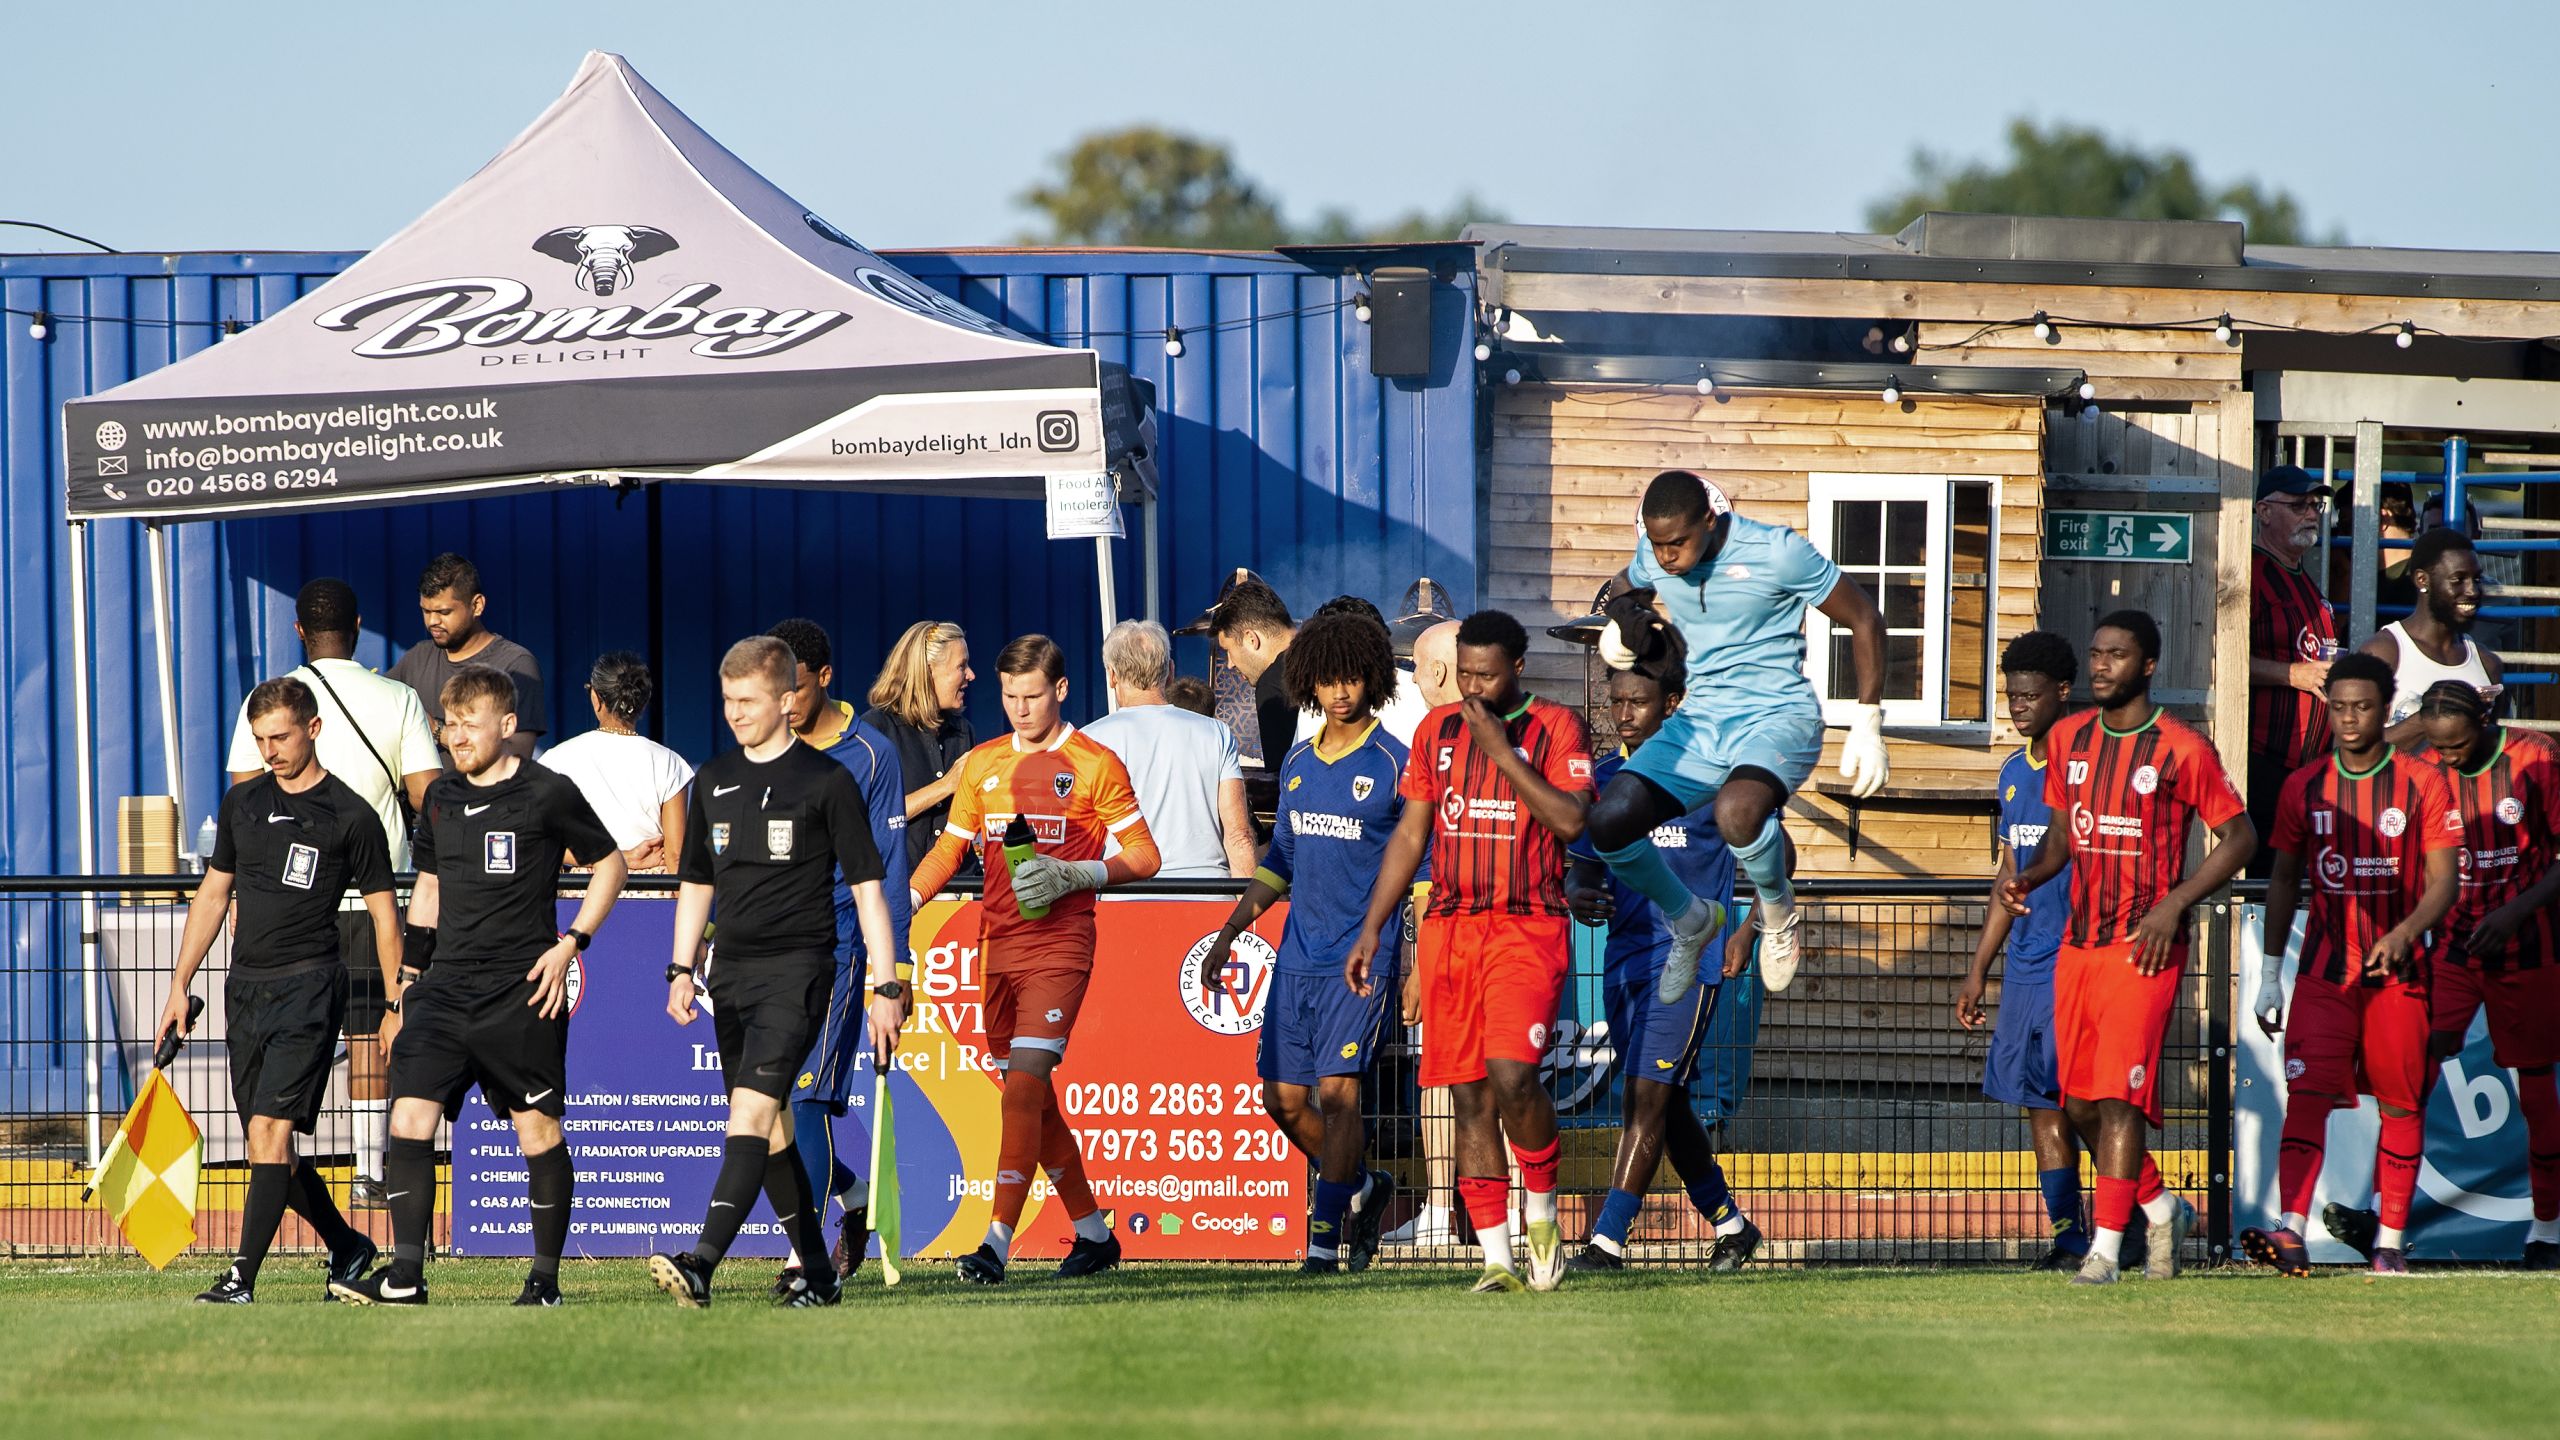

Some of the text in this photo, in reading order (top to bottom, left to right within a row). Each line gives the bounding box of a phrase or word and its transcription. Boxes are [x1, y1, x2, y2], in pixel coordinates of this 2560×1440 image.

[313, 276, 853, 360] Bombay
[480, 347, 652, 368] DELIGHT
[142, 397, 498, 441] www.bombaydelight.co.uk
[145, 427, 504, 472] info@bombaydelight.co.uk
[832, 432, 1032, 457] bombaydelight_ldn
[146, 467, 339, 498] 020 4568 6294
[1058, 478, 1091, 490] Food
[1094, 490, 1104, 498] or
[1060, 499, 1112, 511] Intolera
[2059, 519, 2090, 534] Fire
[2059, 537, 2089, 551] exit
[1438, 746, 1453, 771] 5
[2067, 760, 2090, 785] 10
[1469, 798, 1517, 810] BANQUET
[1302, 812, 1363, 830] FOOTBALL
[1468, 808, 1517, 821] RECORDS
[2099, 814, 2142, 827] BANQUET
[2312, 810, 2333, 835] 11
[1301, 823, 1362, 840] MANAGER
[2098, 825, 2143, 838] RECORDS
[2477, 846, 2519, 859] BANQUET
[2354, 857, 2399, 867] BANQUET
[2479, 856, 2519, 869] RECORDS
[2354, 867, 2399, 877] RECORDS
[1192, 1005, 1213, 1025] FC
[563, 1094, 622, 1106] ALLATION
[631, 1094, 701, 1106] SERVICING
[1065, 1083, 1266, 1116] 0208 2863 29
[480, 1120, 509, 1131] GAS
[563, 1120, 655, 1132] CERTIFICATES
[480, 1145, 514, 1157] FULL
[581, 1145, 648, 1158] RADIATOR
[650, 1145, 722, 1158] UPGRADES
[1168, 1129, 1224, 1162] 563
[1233, 1129, 1289, 1162] 230
[480, 1171, 530, 1183] CHEMIC
[600, 1171, 665, 1183] FLUSHING
[480, 1197, 509, 1208] GAS
[586, 1197, 671, 1209] CONNECTION
[480, 1223, 506, 1234] ALL
[569, 1222, 589, 1235] OF
[590, 1223, 658, 1235] PLUMBING
[1191, 1211, 1259, 1236] Google
